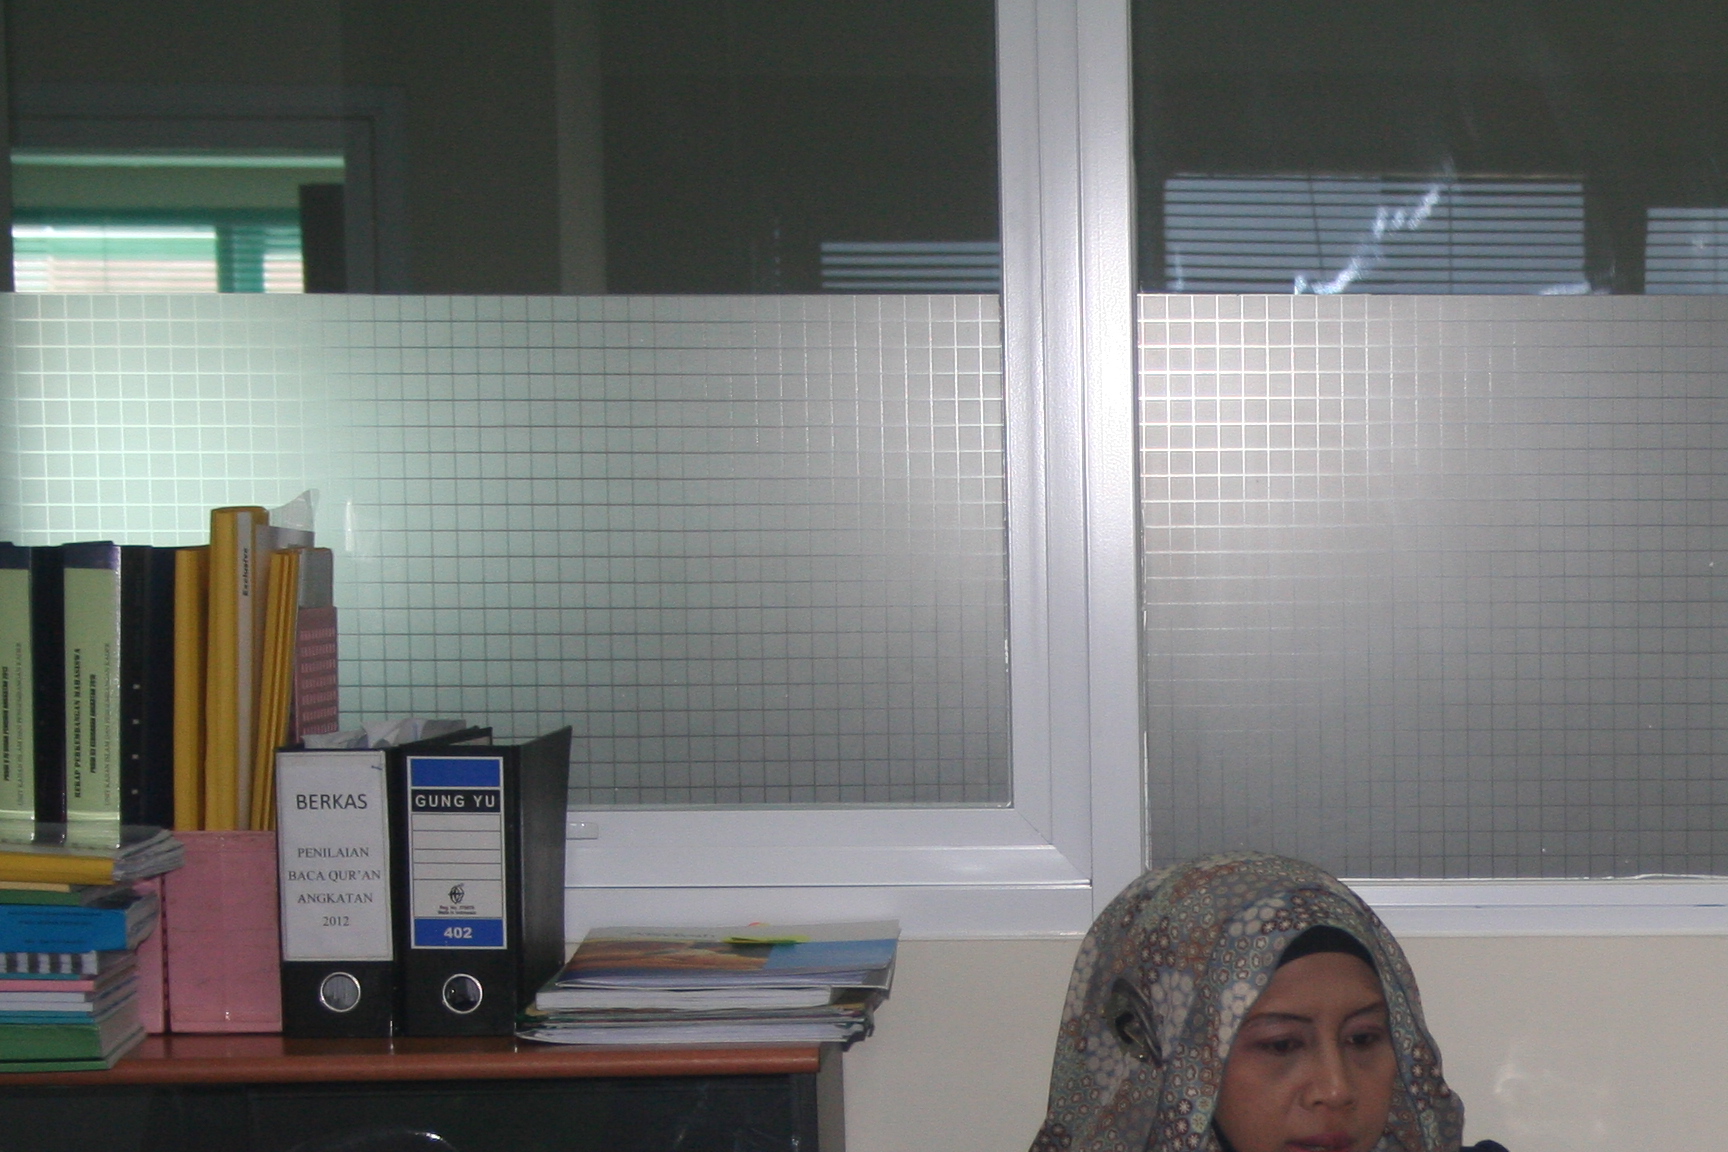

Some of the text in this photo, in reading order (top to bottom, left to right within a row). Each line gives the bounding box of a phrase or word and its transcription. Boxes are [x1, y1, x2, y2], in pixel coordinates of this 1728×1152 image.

[296, 794, 368, 810] BERKAS
[415, 795, 496, 807] GUNG YU
[297, 847, 369, 858] PENILAIAN
[288, 869, 381, 882] BACA QUR'AN
[297, 893, 373, 904] ANGKATAN
[322, 916, 350, 927] 2012
[443, 927, 473, 939] 402
